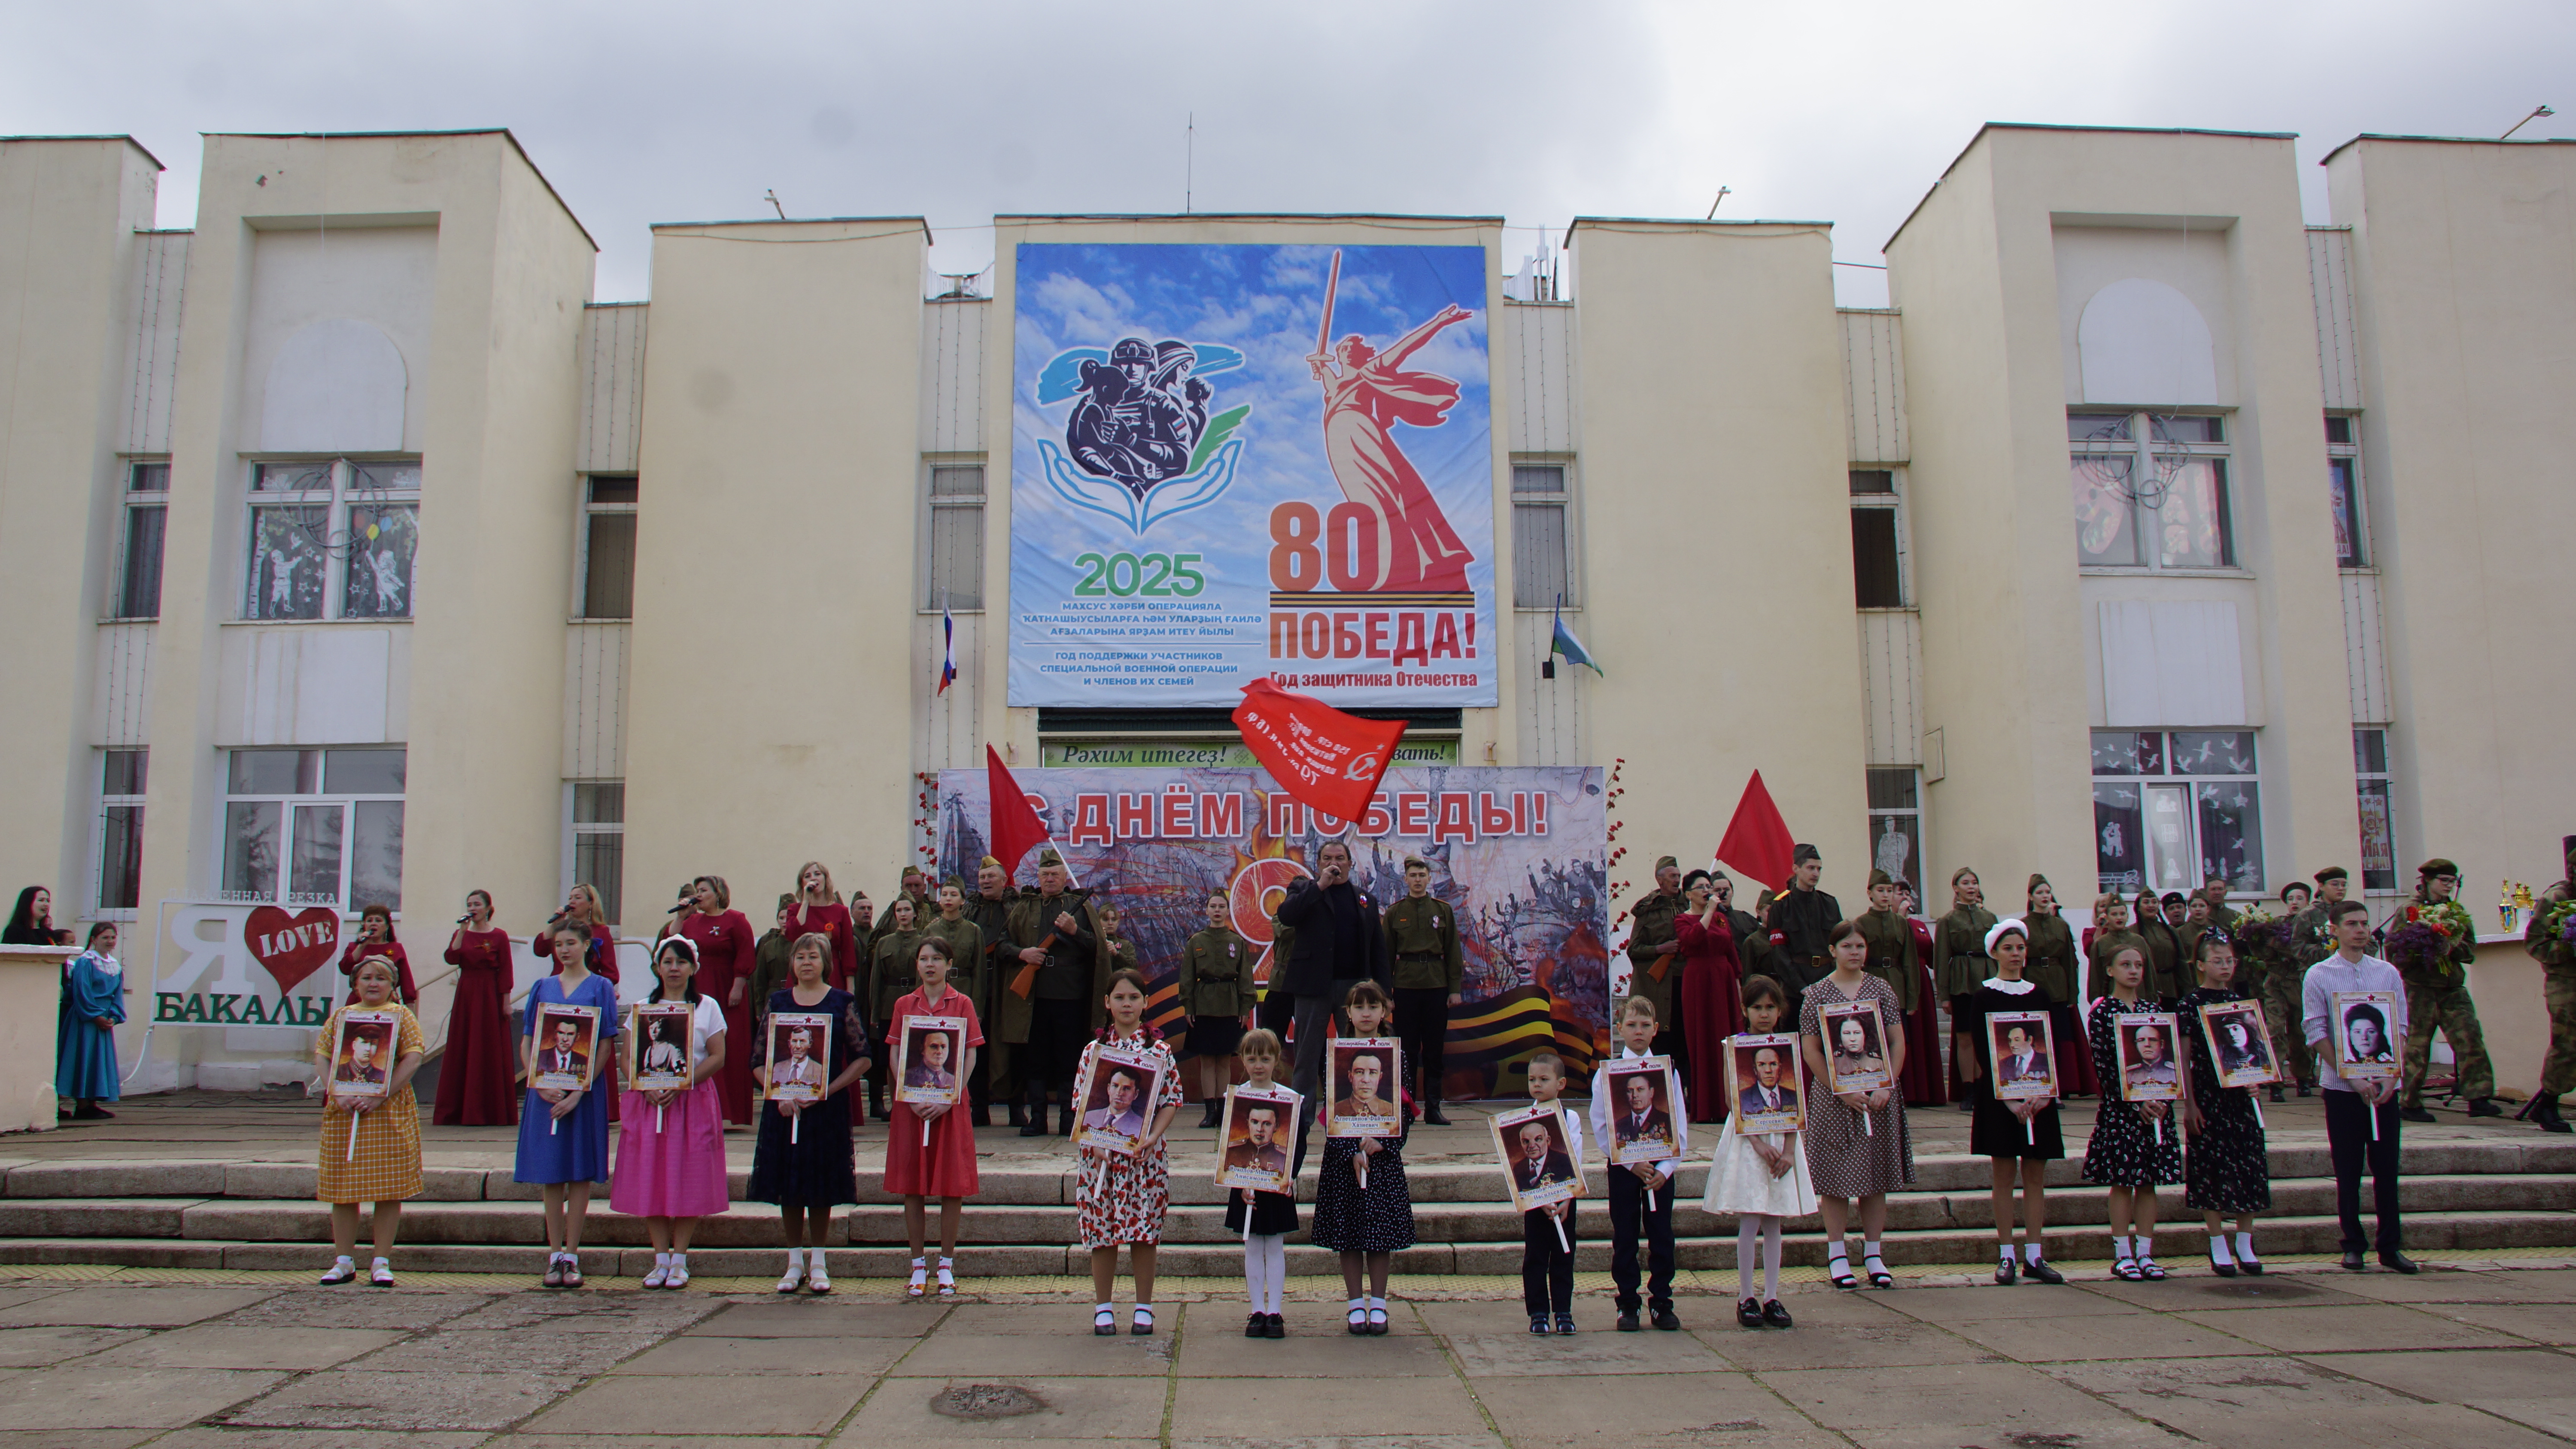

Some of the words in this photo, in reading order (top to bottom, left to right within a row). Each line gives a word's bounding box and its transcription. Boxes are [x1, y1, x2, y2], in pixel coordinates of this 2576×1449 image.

[1269, 501, 1379, 592] 80
[1073, 552, 1205, 597] 2025
[1148, 603, 1221, 611] ОПЕРАЦИЯЛА
[1169, 615, 1222, 624] УЛАРҘЫҢ
[1129, 628, 1165, 637] ЯРҘАМ
[1199, 626, 1234, 636] ЙЫЛЫ
[1269, 612, 1476, 668] ПОБЕДА!
[1055, 652, 1076, 661] ГОД
[1079, 652, 1148, 661] ПОДДЕРЖКИ
[1040, 663, 1121, 673] СПЕЦИАЛЬНОЙ
[1125, 663, 1176, 673] ВОЕННОЙ
[1179, 665, 1238, 673] ОПЕРАЦИИ
[1158, 676, 1194, 685] СЕМЕЙ
[1270, 672, 1298, 688] Год
[1302, 673, 1392, 688] защитника
[1396, 671, 1478, 687] Отечества
[1062, 746, 1134, 763] Рәхим
[1141, 746, 1227, 767] итегеҙ!
[1392, 745, 1445, 760] вать!
[1069, 783, 1243, 847] ДНЁМ
[1268, 790, 1548, 845] ПОБЕДЫ!
[2363, 858, 2390, 870] ЕДА!
[288, 892, 336, 903] РЕЗКА
[259, 921, 334, 958] LOVE
[156, 904, 255, 994] Я
[154, 992, 334, 1026] БАКАЛЫ
[1092, 1136, 1123, 1147] Латыпович
[1234, 1173, 1271, 1182] Анисимович
[1255, 1169, 1279, 1177] Михаил
[1519, 1187, 1546, 1198] Кузнецов
[1547, 1179, 1577, 1190] Александр
[1534, 1188, 1567, 1200] Васильевич
